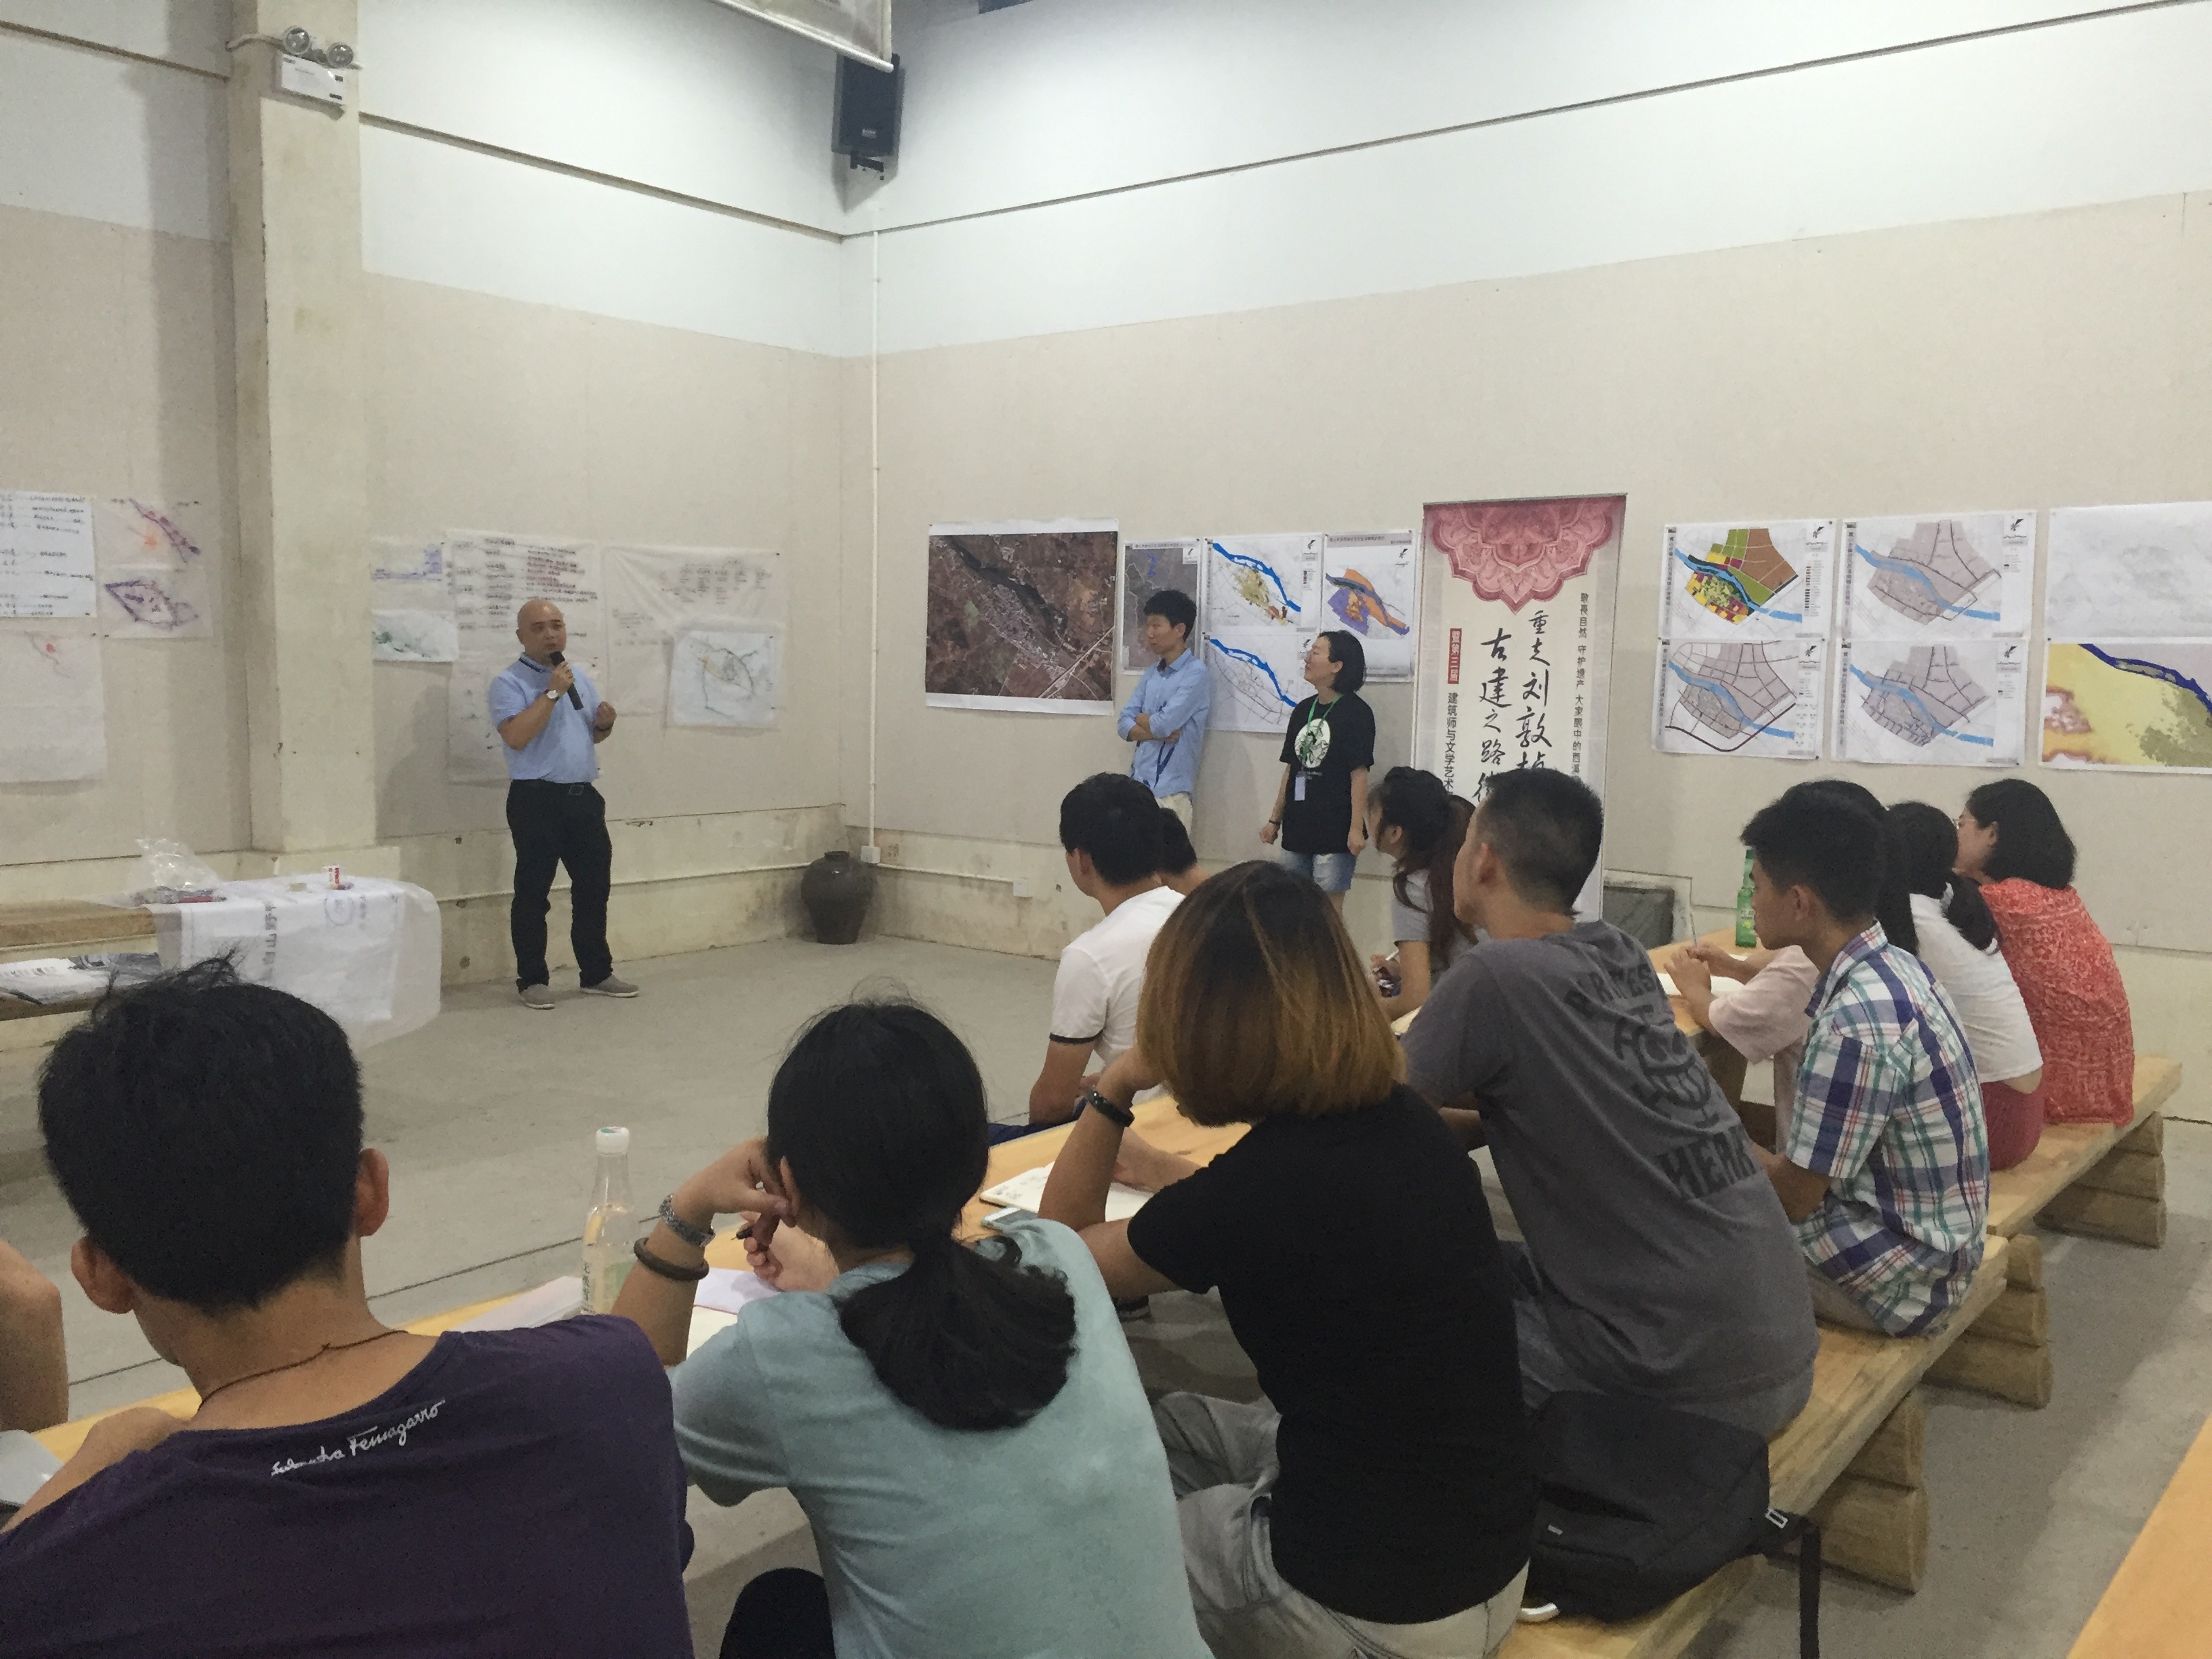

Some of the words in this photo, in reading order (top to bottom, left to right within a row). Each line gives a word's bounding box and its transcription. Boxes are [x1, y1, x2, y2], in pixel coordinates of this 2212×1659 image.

[1443, 692, 1459, 796] 建筑师与文学艺术
